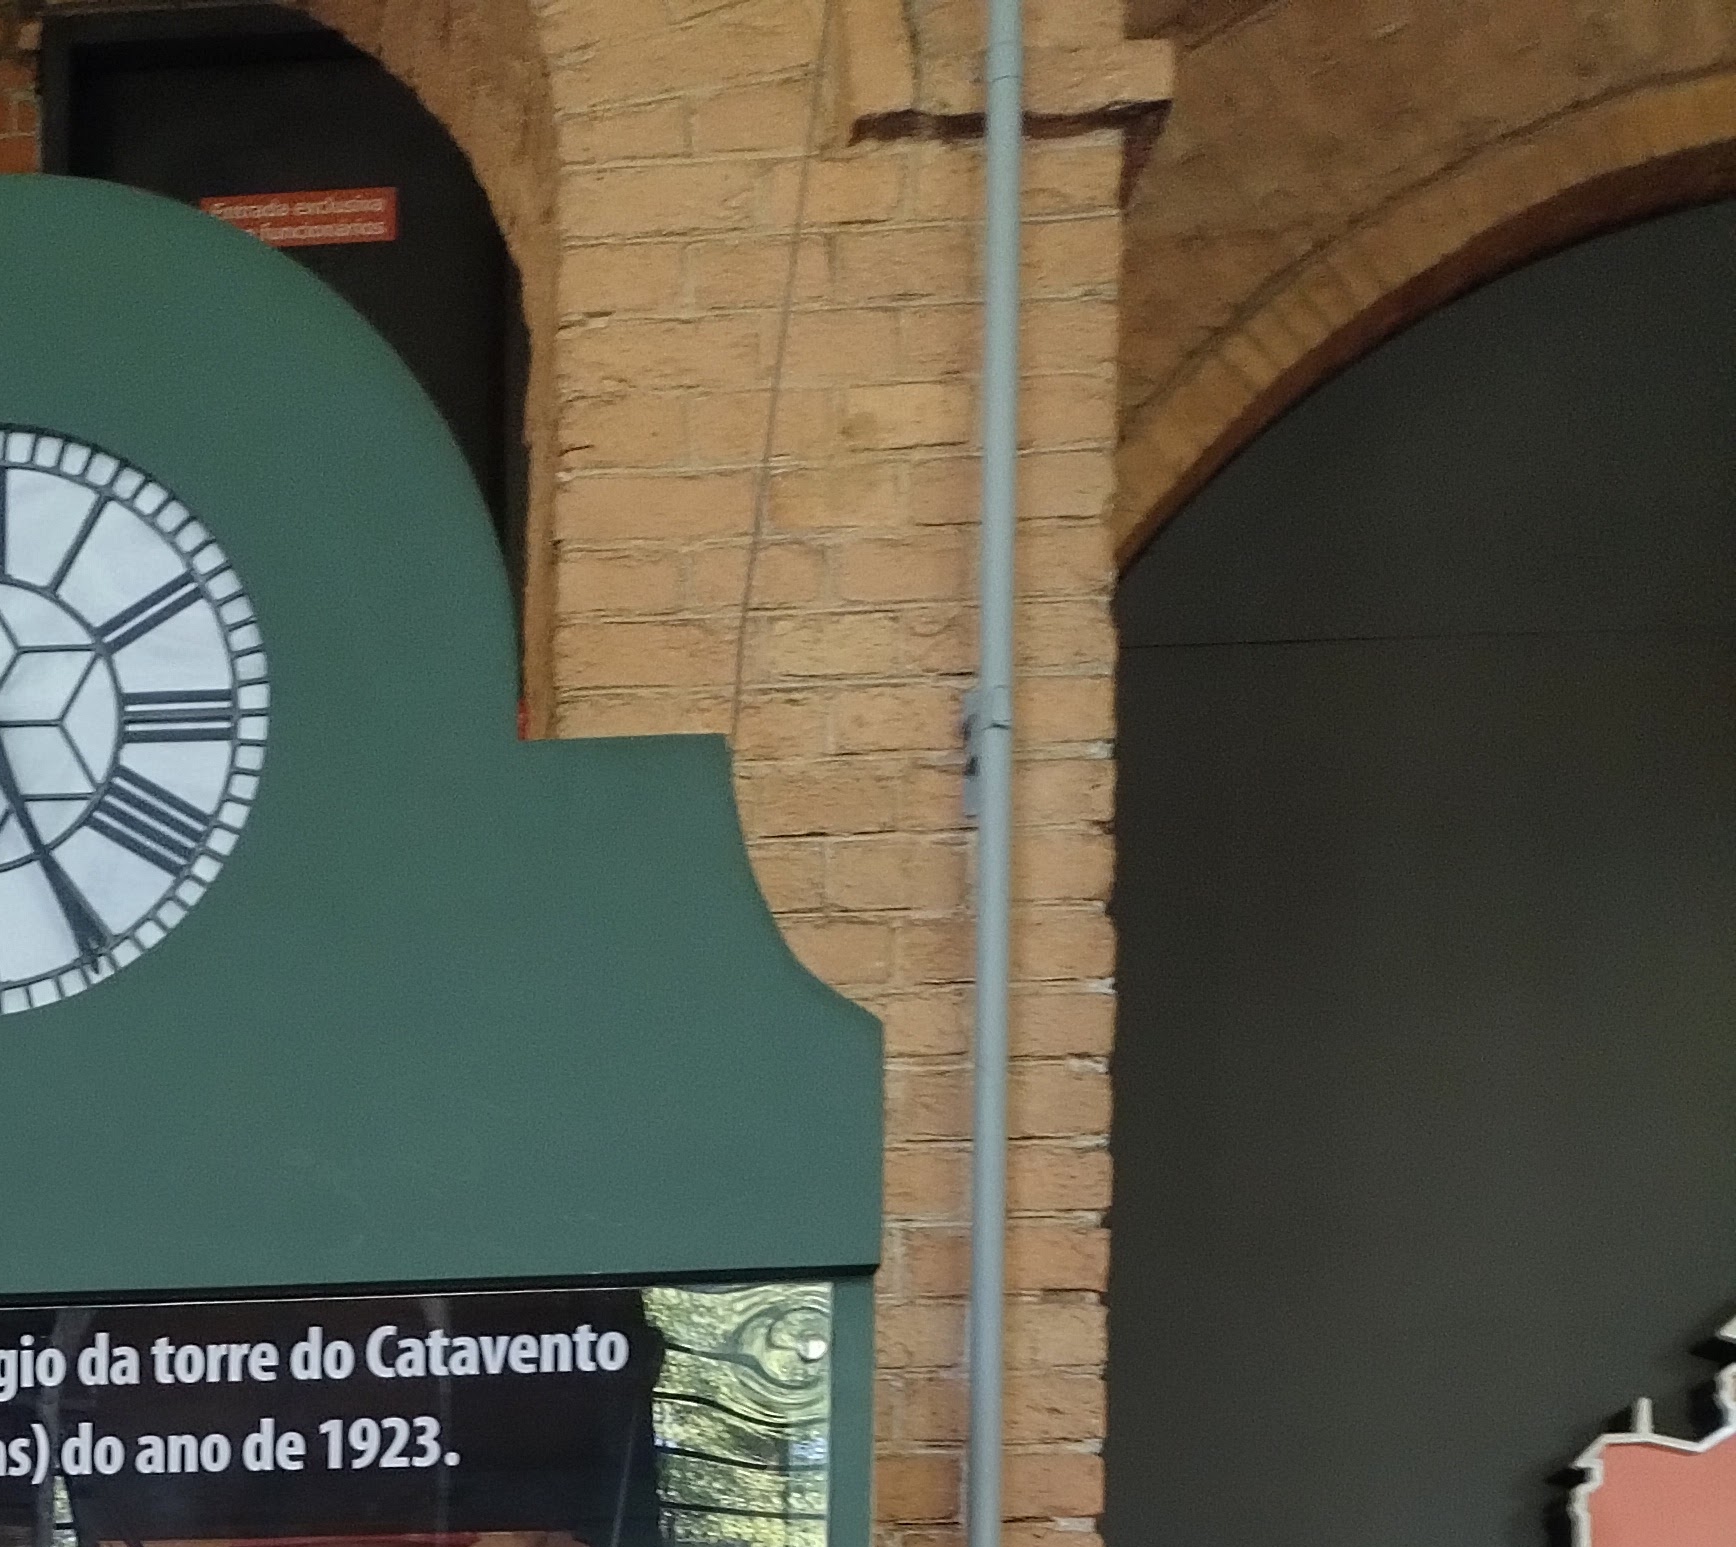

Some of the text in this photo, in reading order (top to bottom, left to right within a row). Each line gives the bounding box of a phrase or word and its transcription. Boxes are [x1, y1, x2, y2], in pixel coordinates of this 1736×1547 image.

[78, 1332, 139, 1386] da
[151, 1336, 279, 1386] torre
[290, 1326, 355, 1380] do
[366, 1324, 629, 1378] Catavento
[61, 1422, 125, 1475] do
[136, 1434, 231, 1474] ano
[242, 1417, 306, 1472] de
[319, 1415, 461, 1469] 1923.
